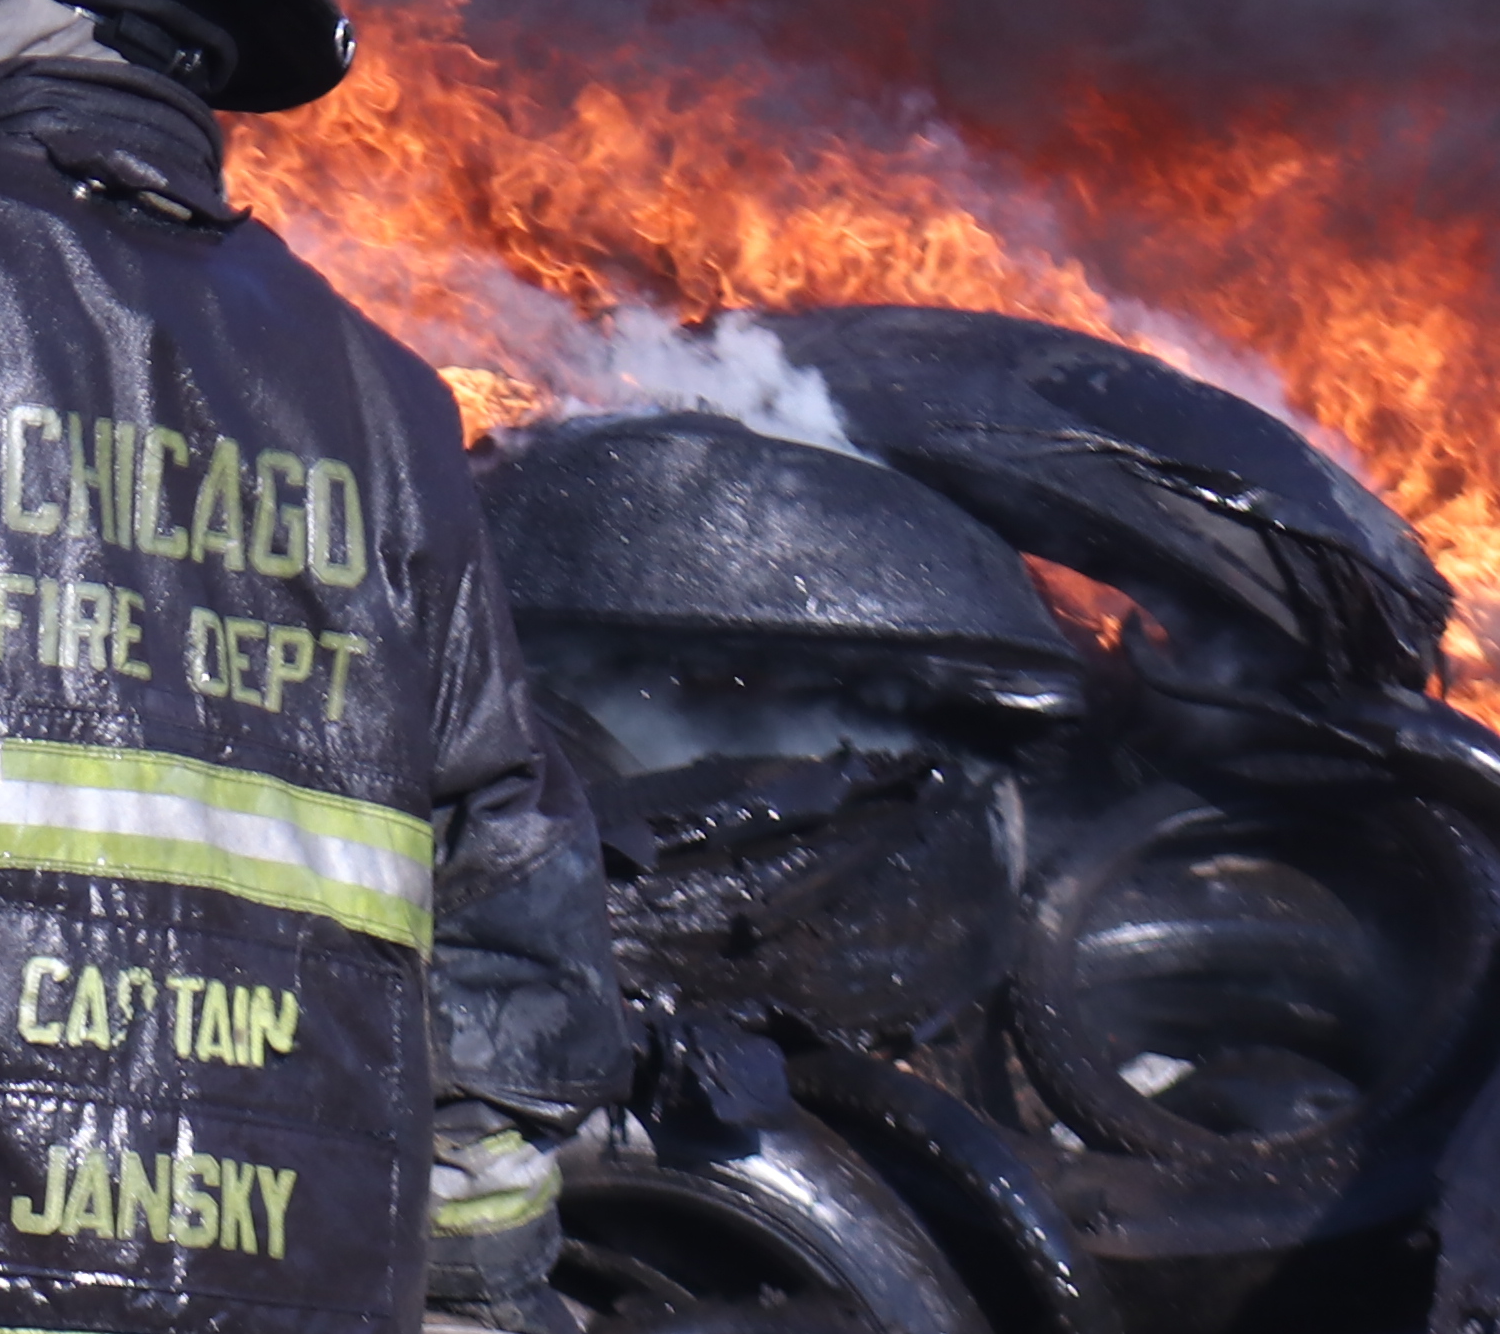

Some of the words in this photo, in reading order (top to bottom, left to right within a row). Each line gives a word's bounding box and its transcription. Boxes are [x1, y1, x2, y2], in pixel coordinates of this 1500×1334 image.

[5, 404, 368, 588] CHICAGO
[185, 607, 368, 722] DEPT
[11, 1145, 297, 1259] JANSKY
